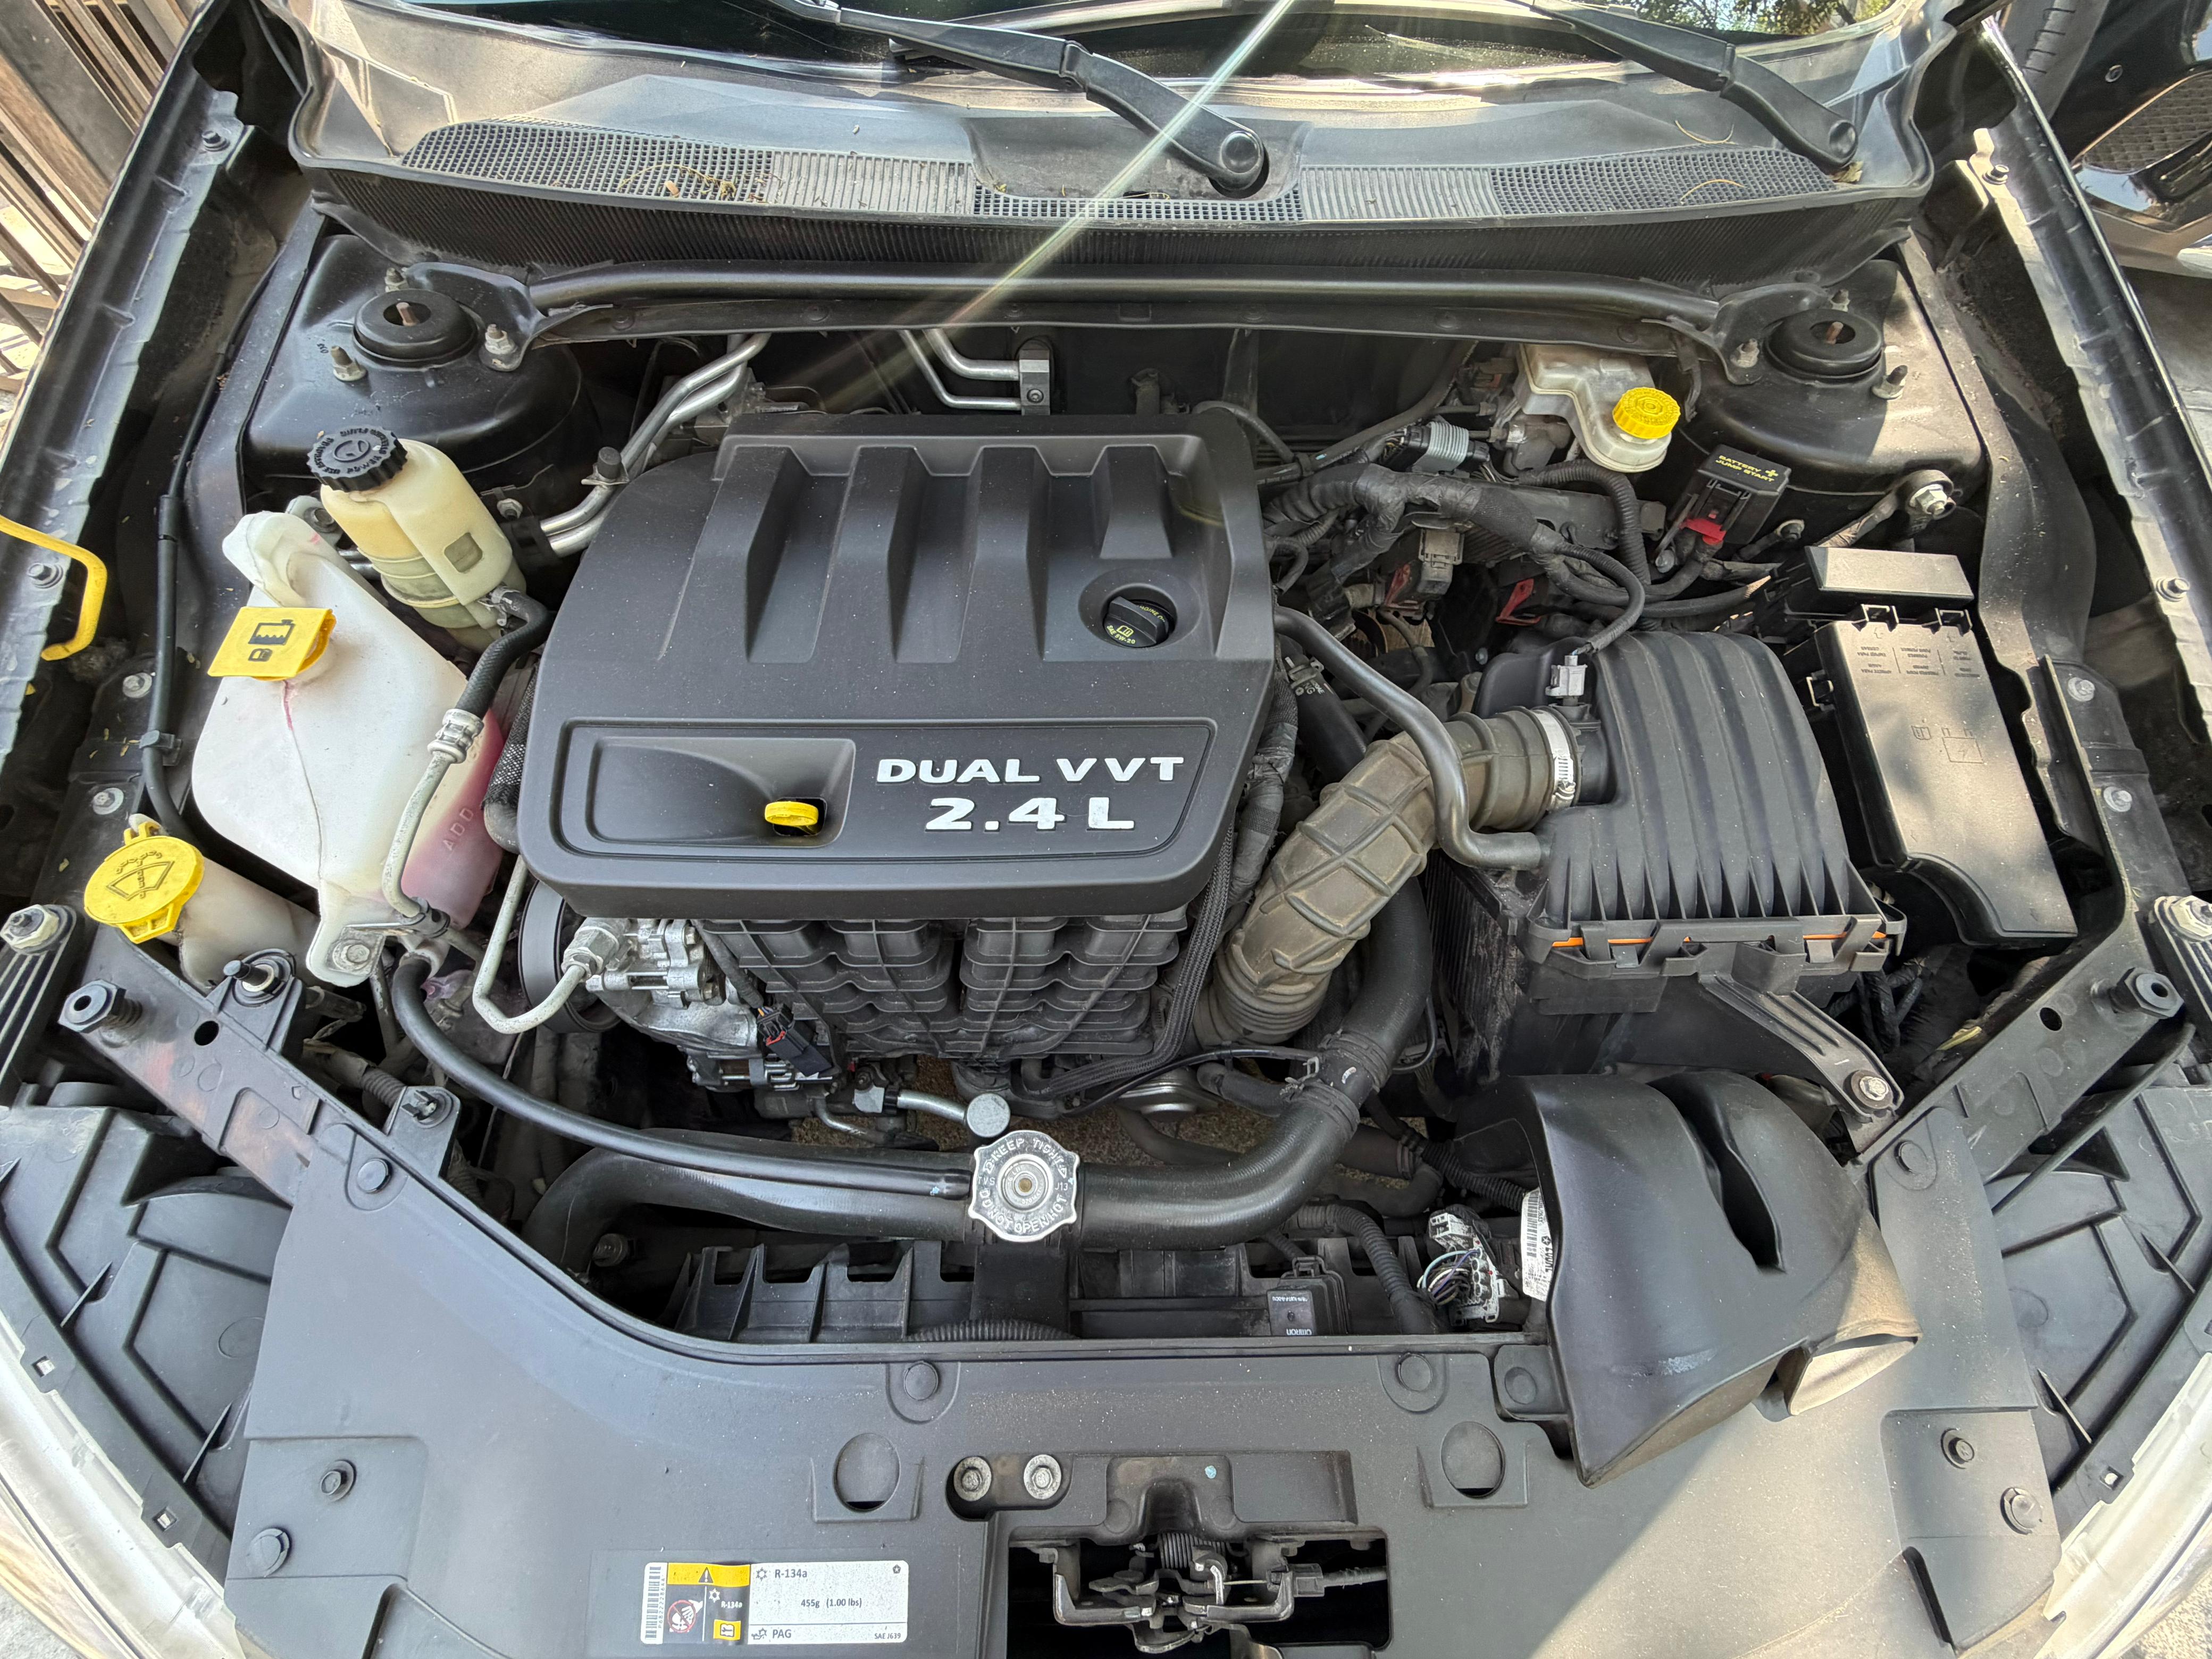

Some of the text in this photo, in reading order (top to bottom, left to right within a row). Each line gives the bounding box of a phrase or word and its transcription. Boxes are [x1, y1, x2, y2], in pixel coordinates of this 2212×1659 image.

[347, 455, 382, 474] POWER
[1715, 459, 1775, 482] JUMP START
[1719, 455, 1762, 472] BATTERY
[1107, 624, 1136, 644] SAE 5W-20
[877, 757, 1184, 784] DUAL VVT
[925, 797, 1134, 831] 2.4 L
[442, 807, 474, 851] ADD
[991, 1138, 1064, 1165] KEEP TIGHT
[978, 1176, 995, 1185] TVS
[1055, 1182, 1068, 1191] J13
[979, 1188, 992, 1208] DO
[987, 1209, 1013, 1230] NOT
[1013, 1214, 1051, 1234] OPEN
[1048, 1193, 1068, 1221] HOT
[775, 1569, 808, 1579] R-134a
[801, 1597, 862, 1609] 455g (1.00 lbs)
[772, 1629, 792, 1638] PAG
